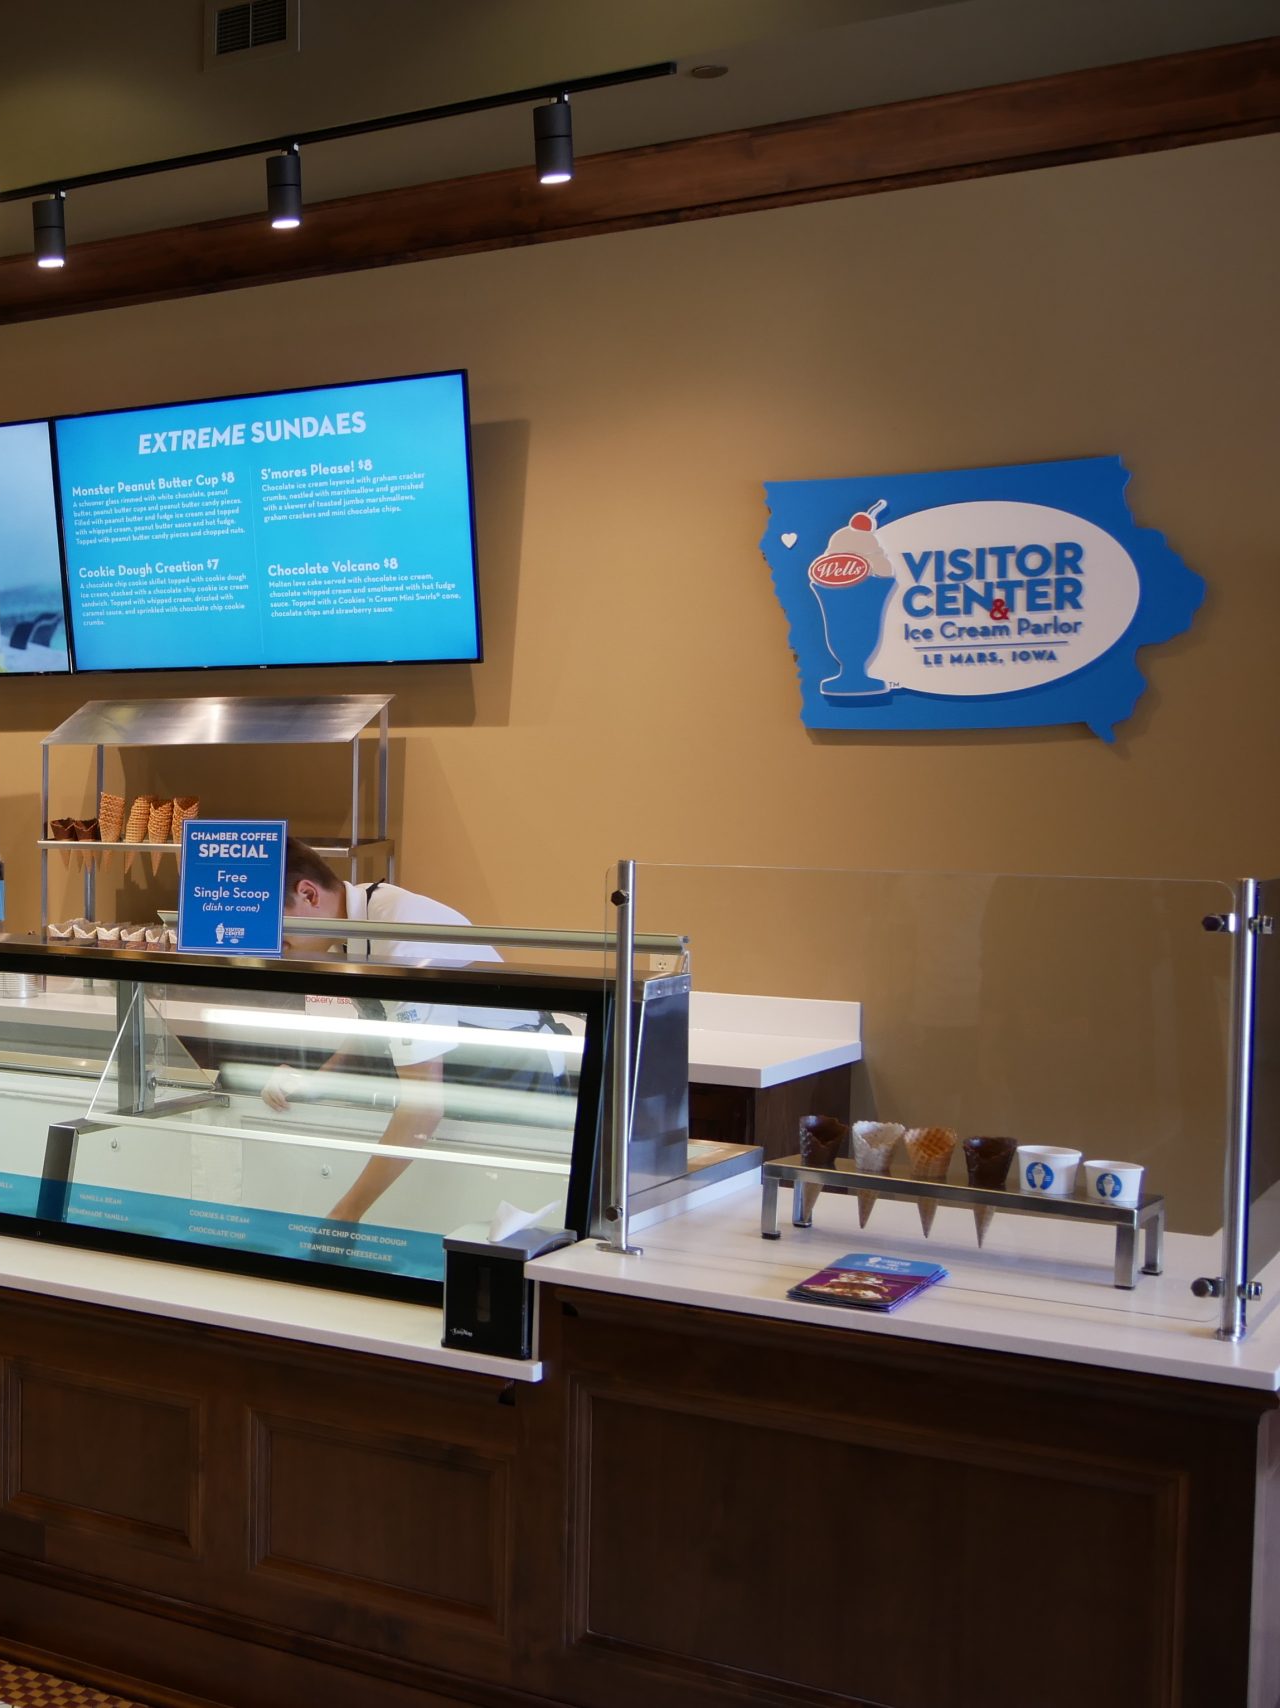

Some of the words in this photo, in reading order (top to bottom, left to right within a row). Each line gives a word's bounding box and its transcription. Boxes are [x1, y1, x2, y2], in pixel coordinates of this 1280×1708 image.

[136, 422, 247, 455] EXTREME
[249, 409, 367, 444] SUNDAES
[260, 464, 307, 480] S’mores
[309, 459, 355, 476] Please!
[357, 458, 374, 472] $8
[71, 483, 115, 497] Monster
[116, 478, 156, 493] Peanut
[157, 474, 193, 489] Butter
[194, 472, 219, 489] Cup
[220, 470, 235, 484] $8
[78, 564, 116, 578] Cookie
[117, 562, 153, 579] Dough
[154, 559, 204, 574] Creation
[206, 558, 220, 570] $7
[267, 560, 329, 576] Chocolate
[331, 557, 380, 573] Volcano
[383, 556, 399, 570] $8
[816, 558, 868, 579] Wells
[902, 541, 1085, 583] VISITOR
[902, 577, 1084, 618] CENTER
[989, 599, 1010, 621] &
[904, 622, 934, 641] Ice
[939, 619, 1011, 641] Cream
[1017, 615, 1083, 637] Parlor
[923, 653, 943, 666] LE
[949, 651, 1005, 666] MARS,
[1011, 649, 1057, 663] IOWA
[191, 832, 238, 841] CHAMBER
[240, 832, 278, 841] COFFEE
[198, 844, 269, 859] SPECIAL
[217, 870, 248, 883] Free
[194, 887, 230, 900] Single
[233, 887, 270, 901] Scoop
[202, 903, 223, 912] (dish
[236, 904, 260, 912] cone)
[226, 1214, 250, 1224] CREAM
[188, 1225, 229, 1237] CHOCOLATE
[230, 1231, 246, 1240] CHIP
[288, 1223, 331, 1236] CHOCOLATE
[331, 1229, 349, 1238] CHIP
[350, 1232, 378, 1242] COOKIE
[380, 1236, 407, 1246] DOUGH
[300, 1241, 345, 1255] STRAWBERRY
[346, 1248, 393, 1261] CHEESECAKE
